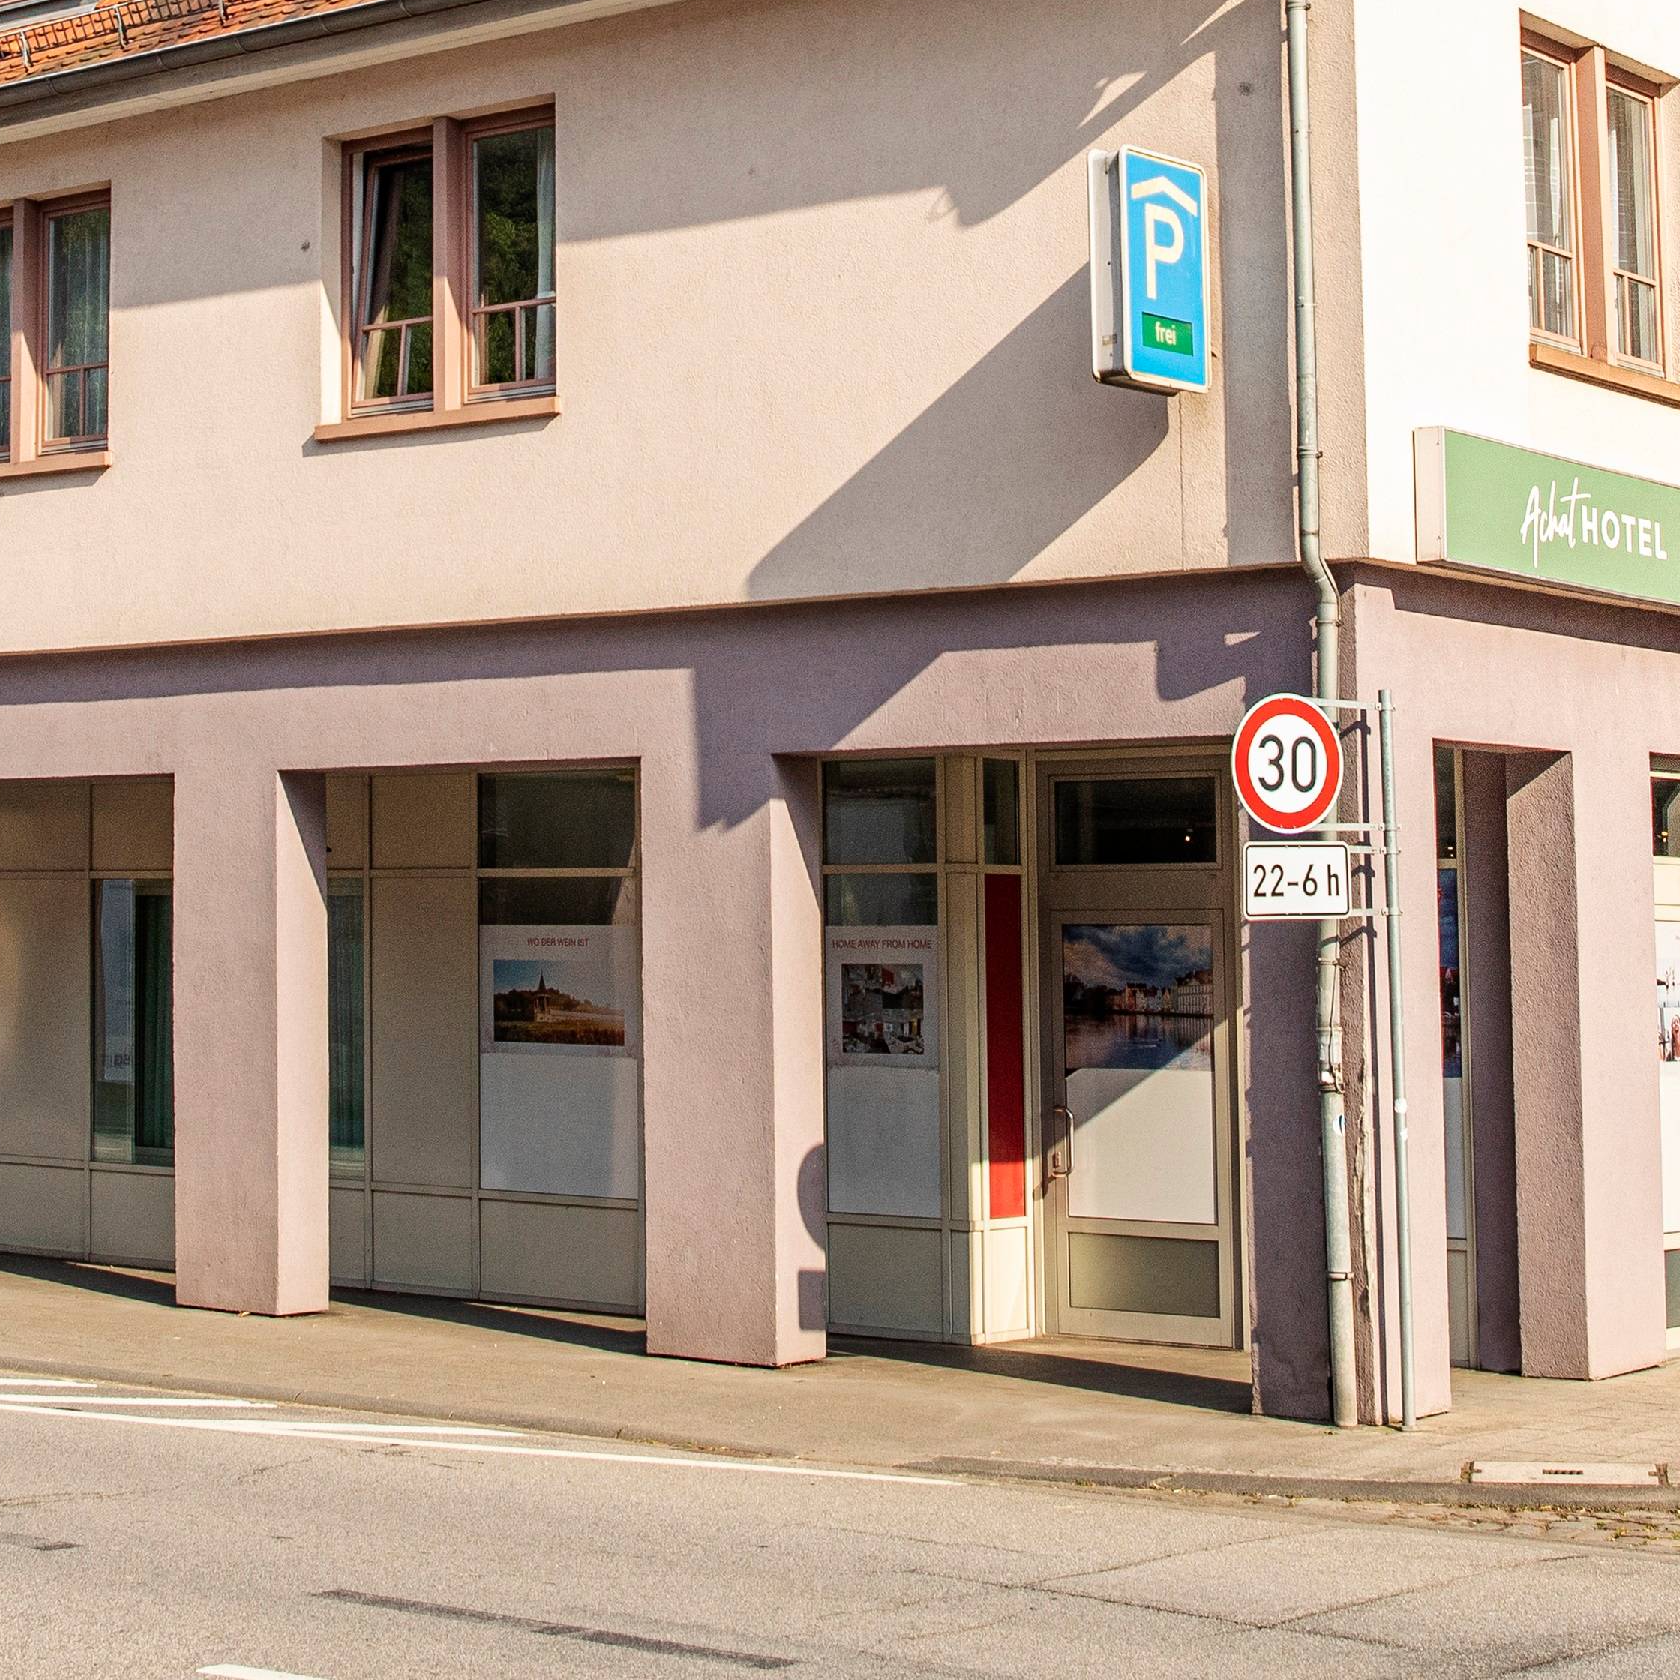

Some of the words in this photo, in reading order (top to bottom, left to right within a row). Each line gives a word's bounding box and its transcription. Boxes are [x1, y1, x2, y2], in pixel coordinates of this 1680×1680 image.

[1144, 202, 1184, 301] P
[1155, 321, 1177, 346] frei
[1520, 477, 1592, 569] Achat
[1581, 504, 1668, 561] HOTEL
[1257, 734, 1317, 793] 30
[1253, 863, 1318, 897] 22-6
[1327, 864, 1340, 896] h
[527, 937, 540, 947] WO
[557, 937, 576, 947] WEIN
